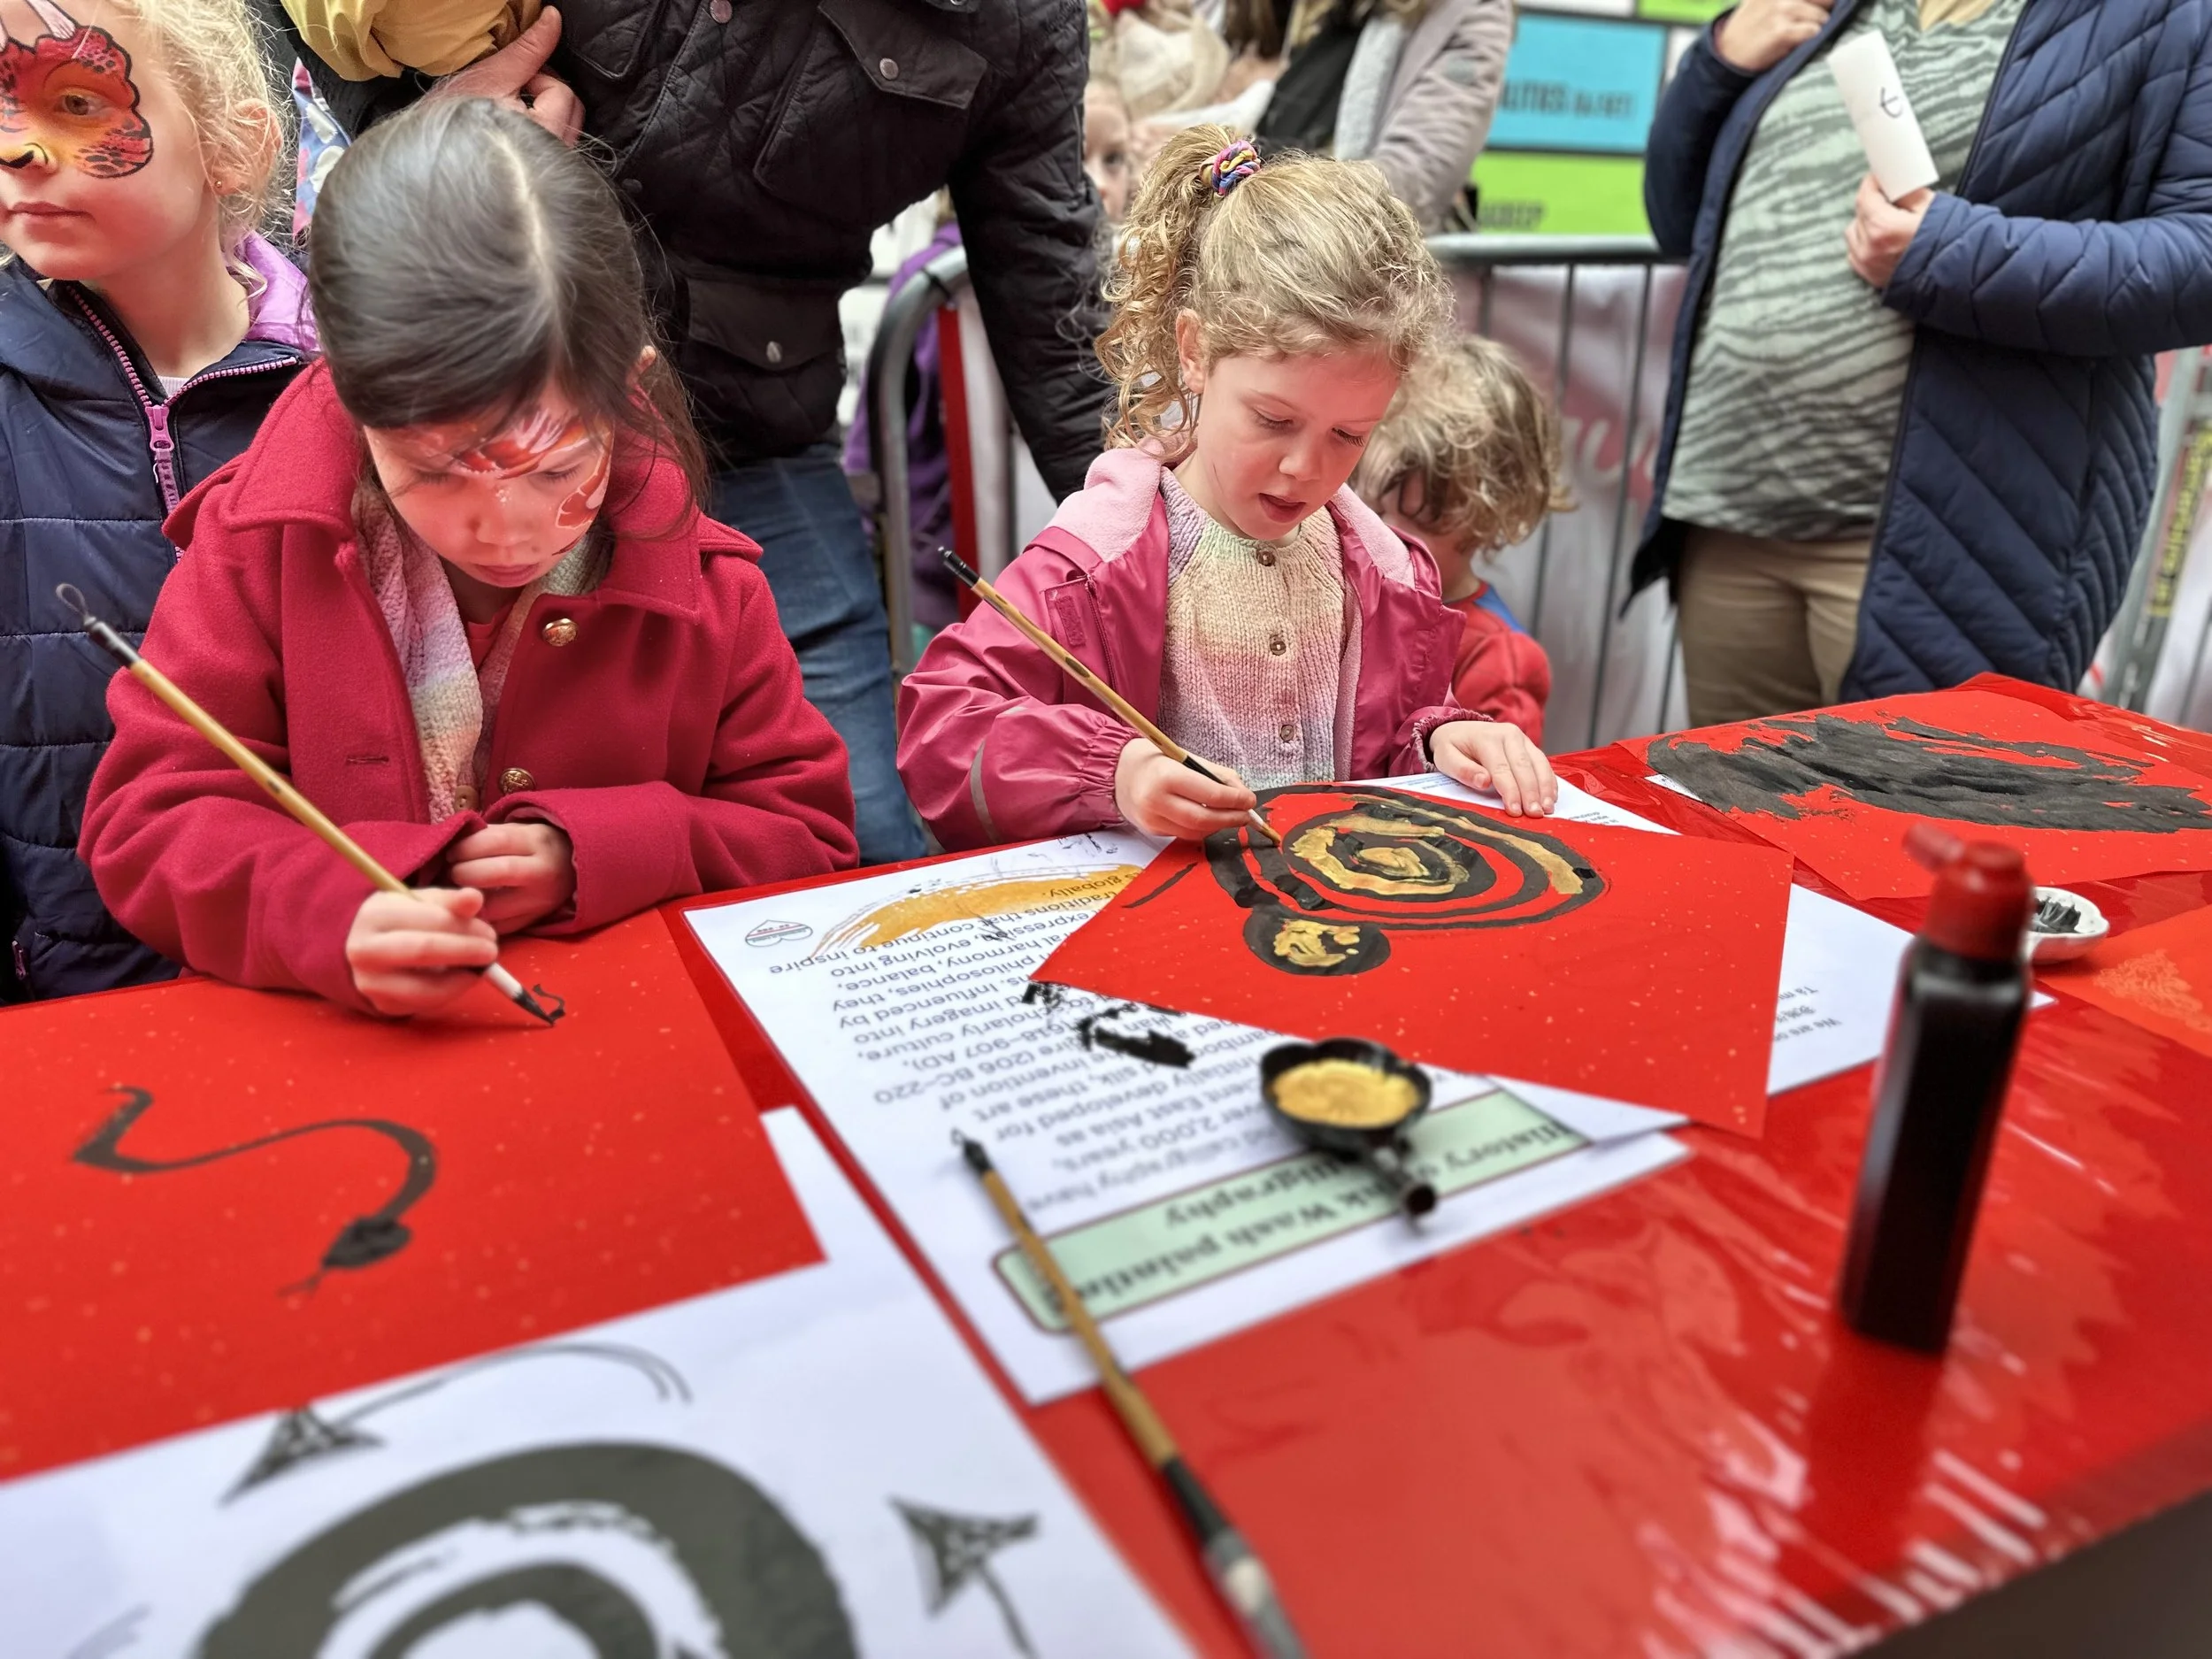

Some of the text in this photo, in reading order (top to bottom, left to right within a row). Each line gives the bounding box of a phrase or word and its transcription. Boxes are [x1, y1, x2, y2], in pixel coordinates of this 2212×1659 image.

[765, 947, 853, 980] inspire
[850, 941, 881, 958] to
[831, 962, 878, 977] into
[838, 956, 936, 990] balance,
[833, 994, 885, 1018] they
[854, 1001, 1003, 1044] imagery into
